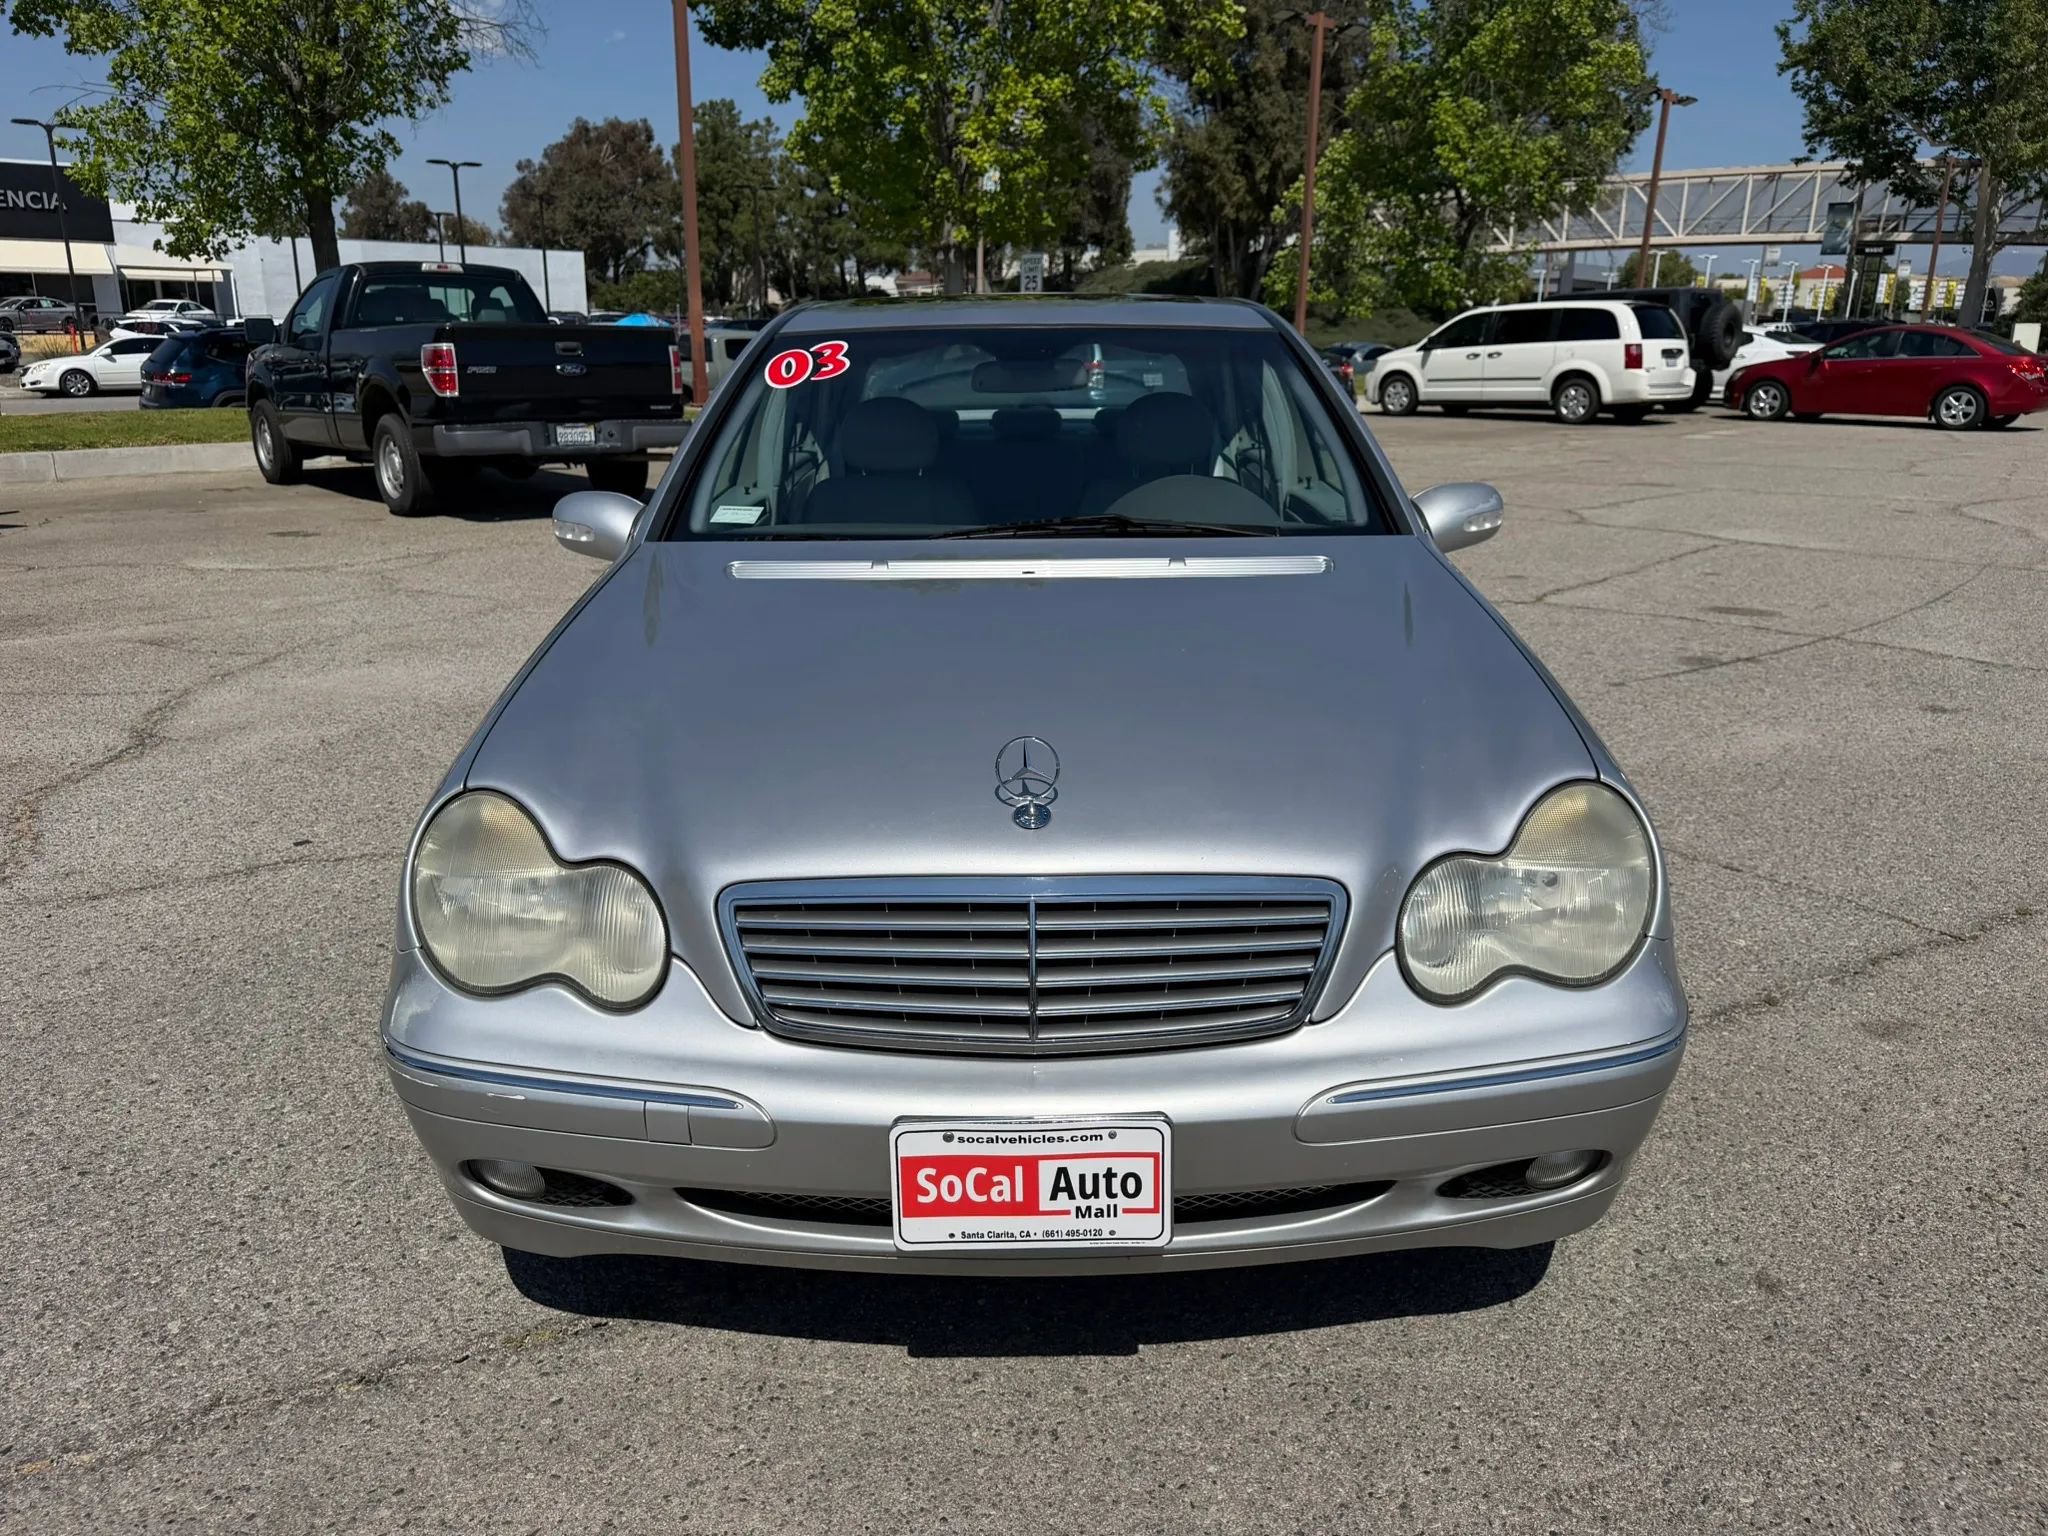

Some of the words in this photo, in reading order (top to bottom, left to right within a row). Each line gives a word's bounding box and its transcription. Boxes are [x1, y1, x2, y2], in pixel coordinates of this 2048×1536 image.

[1024, 274, 1039, 291] 25
[764, 340, 851, 389] 03
[957, 1133, 1103, 1145] socalvehicles.com
[916, 1165, 1024, 1204] SoCal
[1049, 1166, 1143, 1201] Auto
[1075, 1204, 1118, 1219] Mall
[960, 1230, 985, 1240] Santa
[987, 1229, 1018, 1241] Clarita,
[1019, 1230, 1031, 1240] CA
[1041, 1229, 1064, 1240] (661)
[1065, 1228, 1103, 1239] 495-0120
